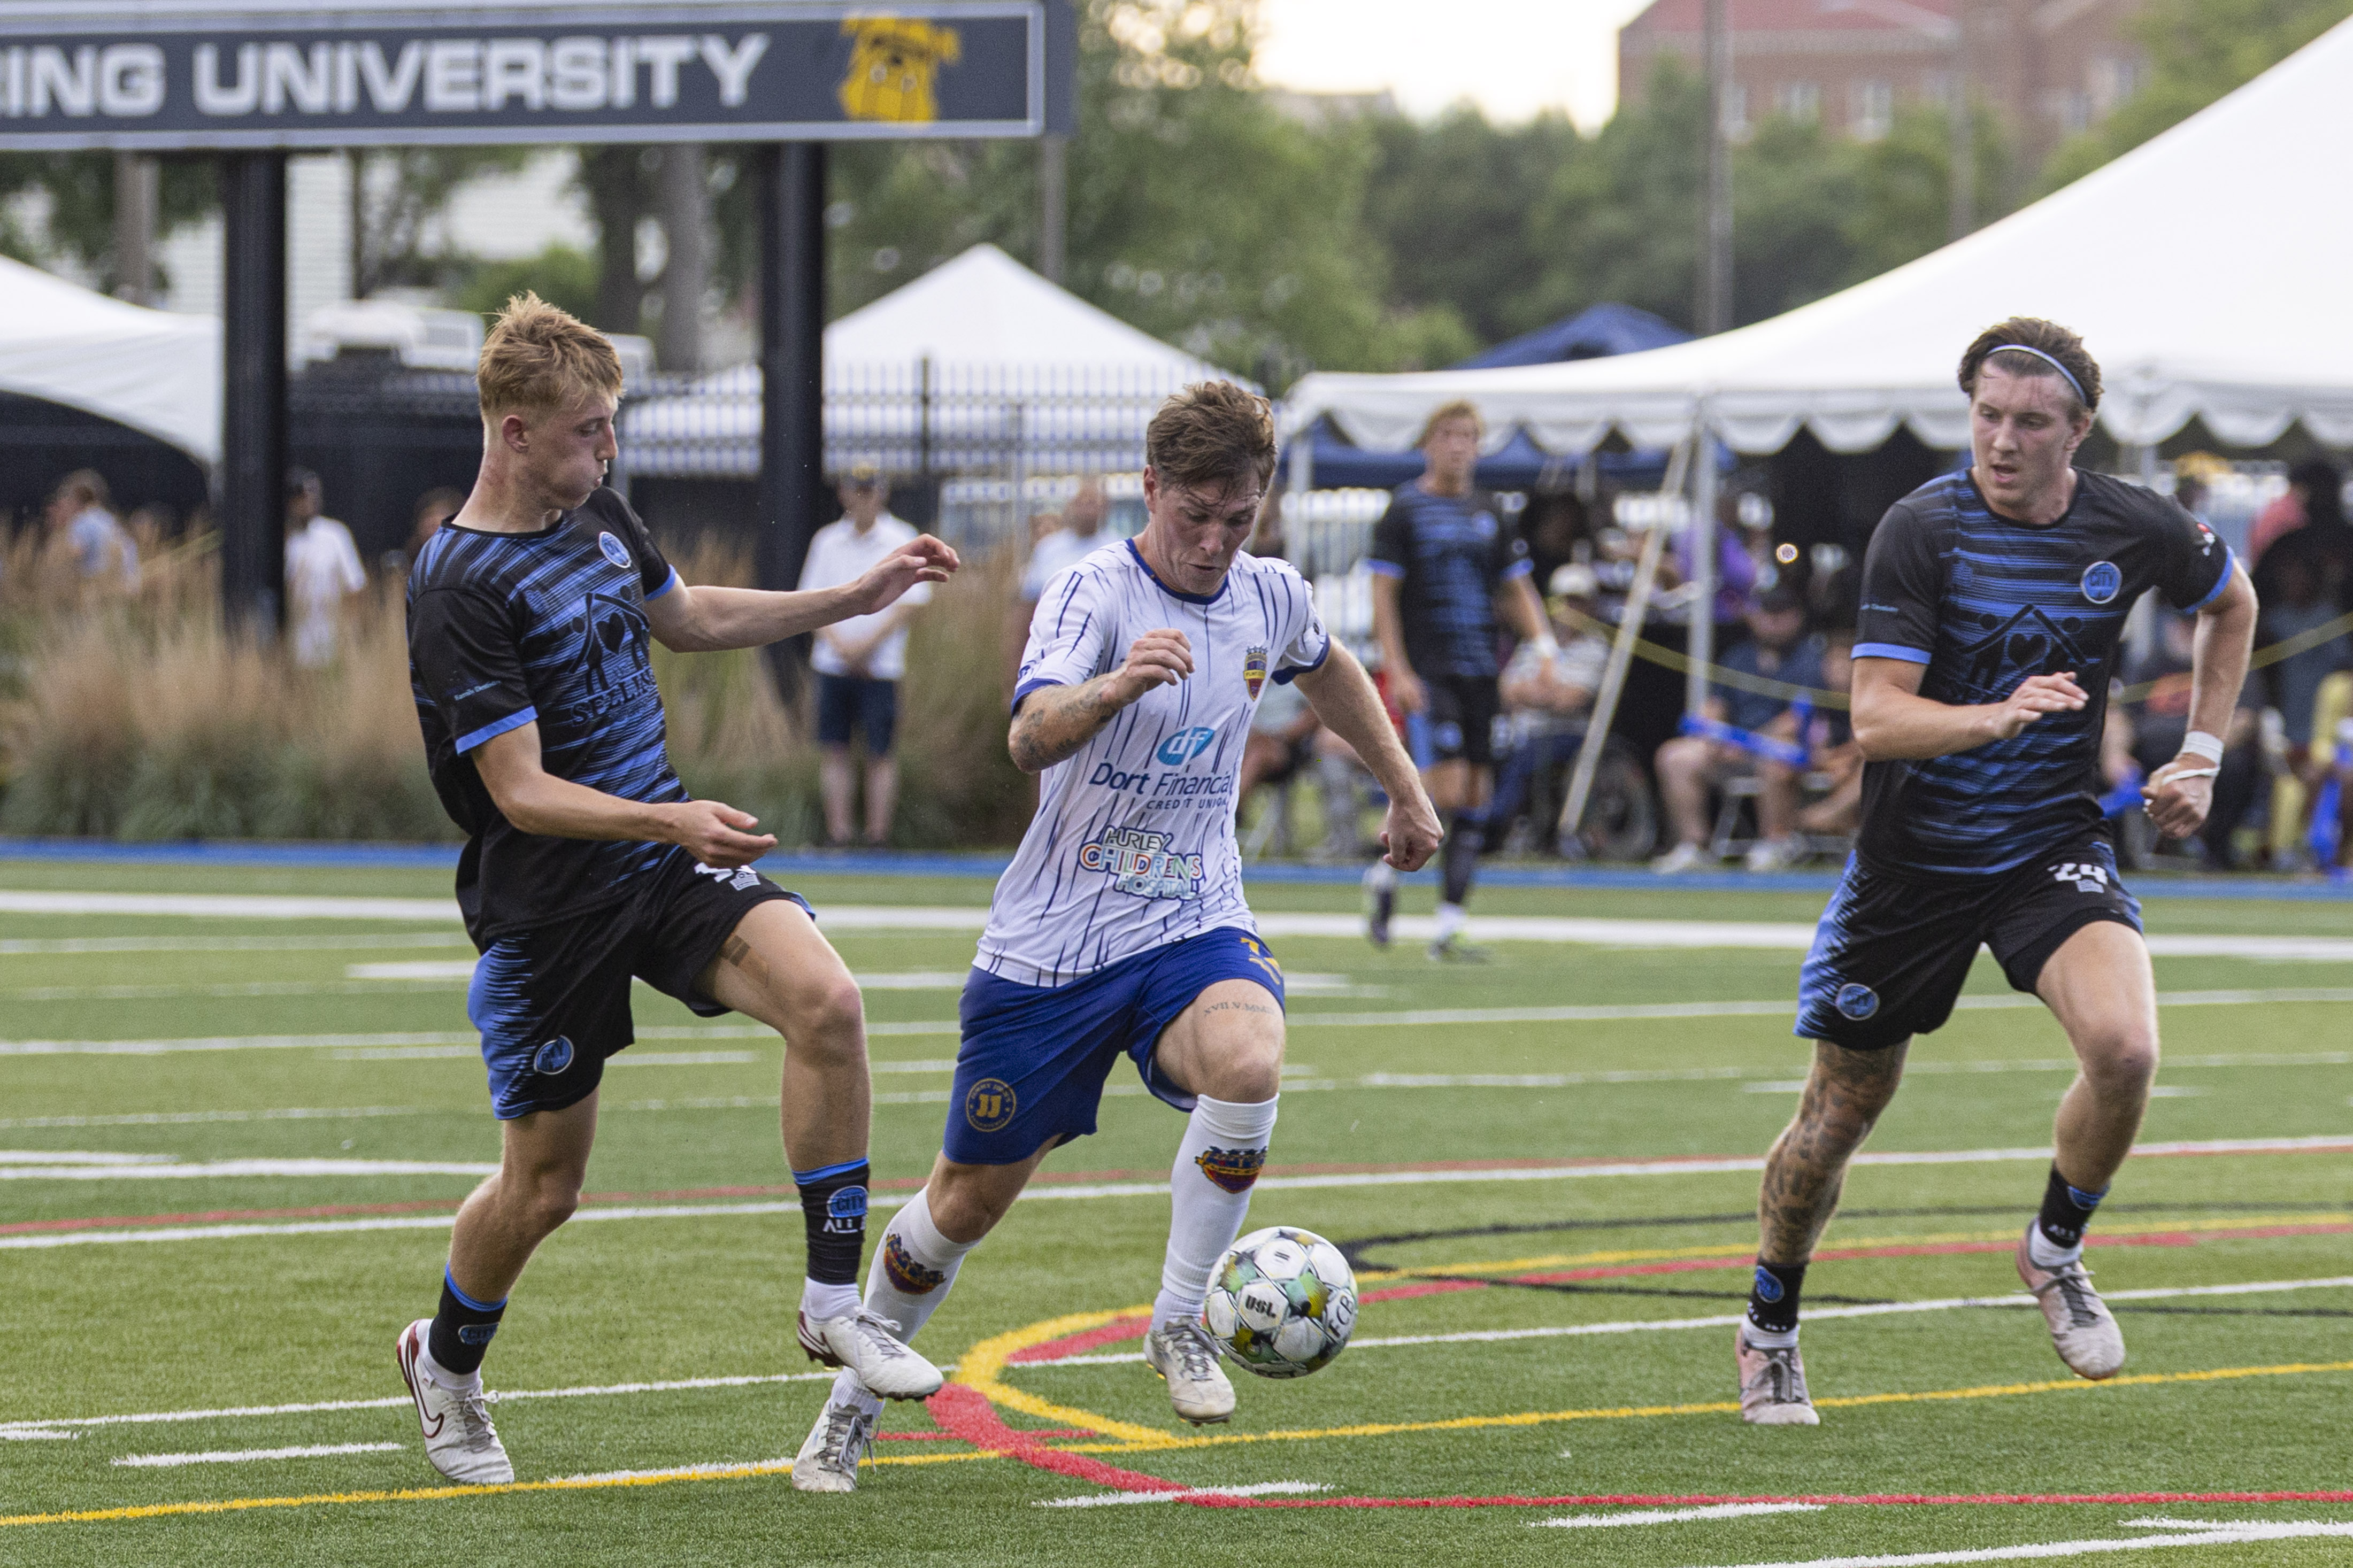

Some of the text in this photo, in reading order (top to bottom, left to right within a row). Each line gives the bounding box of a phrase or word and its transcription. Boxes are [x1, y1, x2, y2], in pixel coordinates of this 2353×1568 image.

[0, 34, 770, 119] ING UNIVERSITY
[1089, 762, 1232, 796] Dort Financia
[1104, 829, 1170, 852] HURLEY
[2047, 862, 2108, 885] 24
[1245, 1294, 1277, 1318] USL
